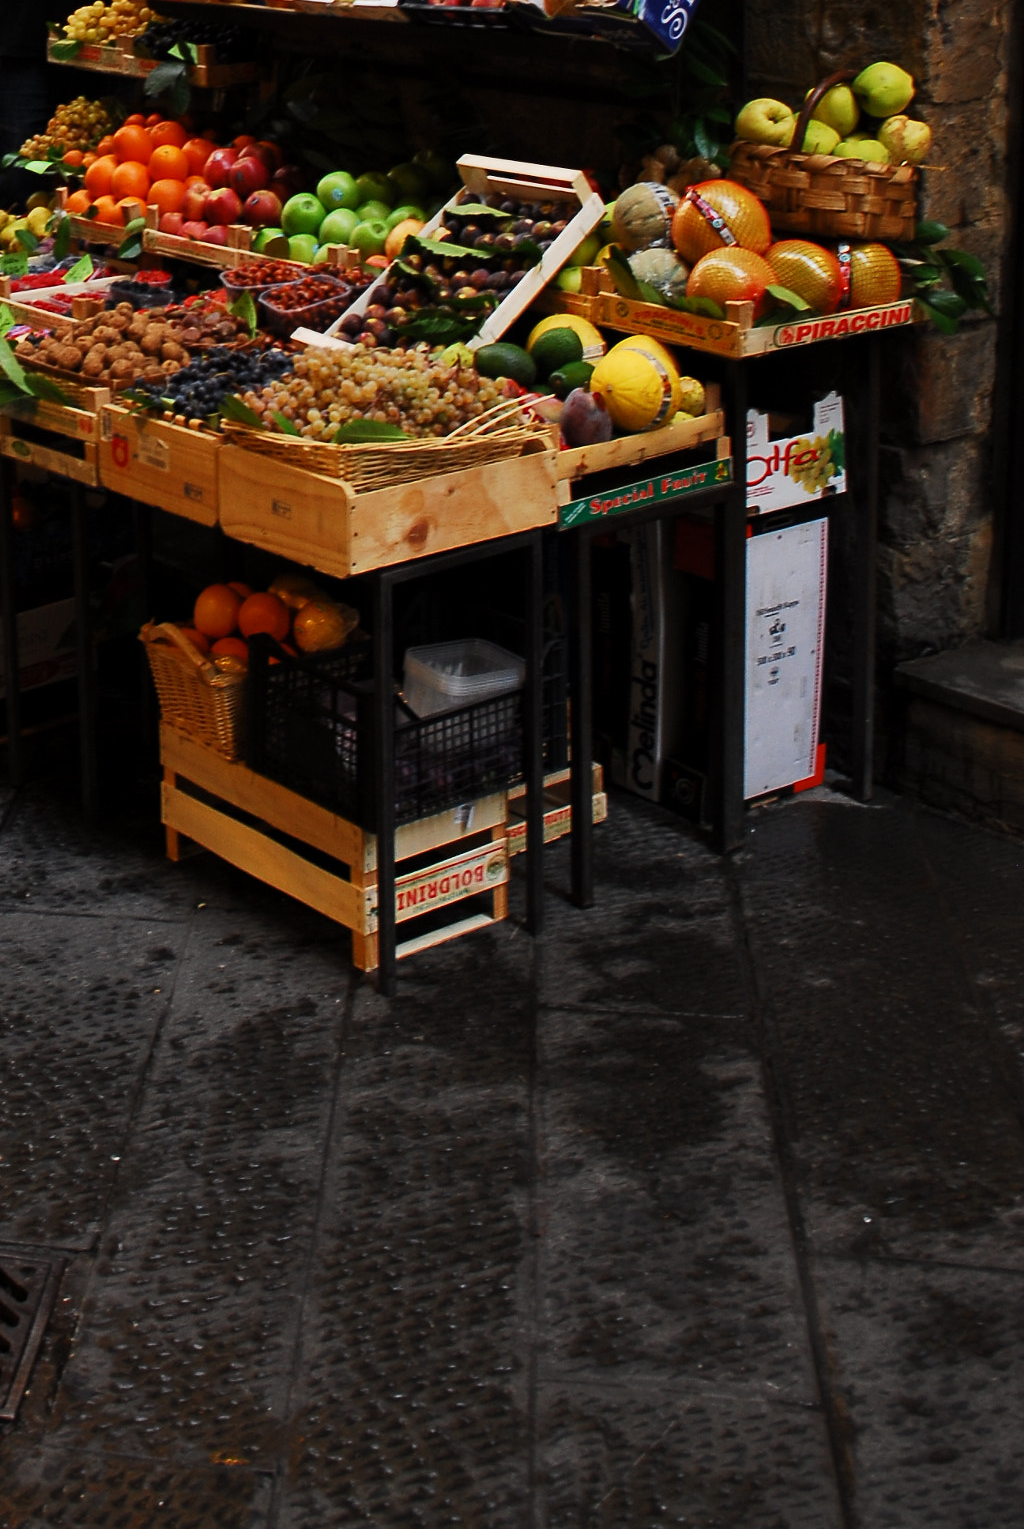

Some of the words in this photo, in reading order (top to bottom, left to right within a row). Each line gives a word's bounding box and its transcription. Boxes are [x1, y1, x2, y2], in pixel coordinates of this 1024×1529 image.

[795, 306, 910, 342] PIRACCINI
[589, 482, 655, 516] Special
[660, 471, 707, 495] Fruit
[630, 660, 658, 791] Melinda
[397, 864, 485, 912] BOLDRINI
